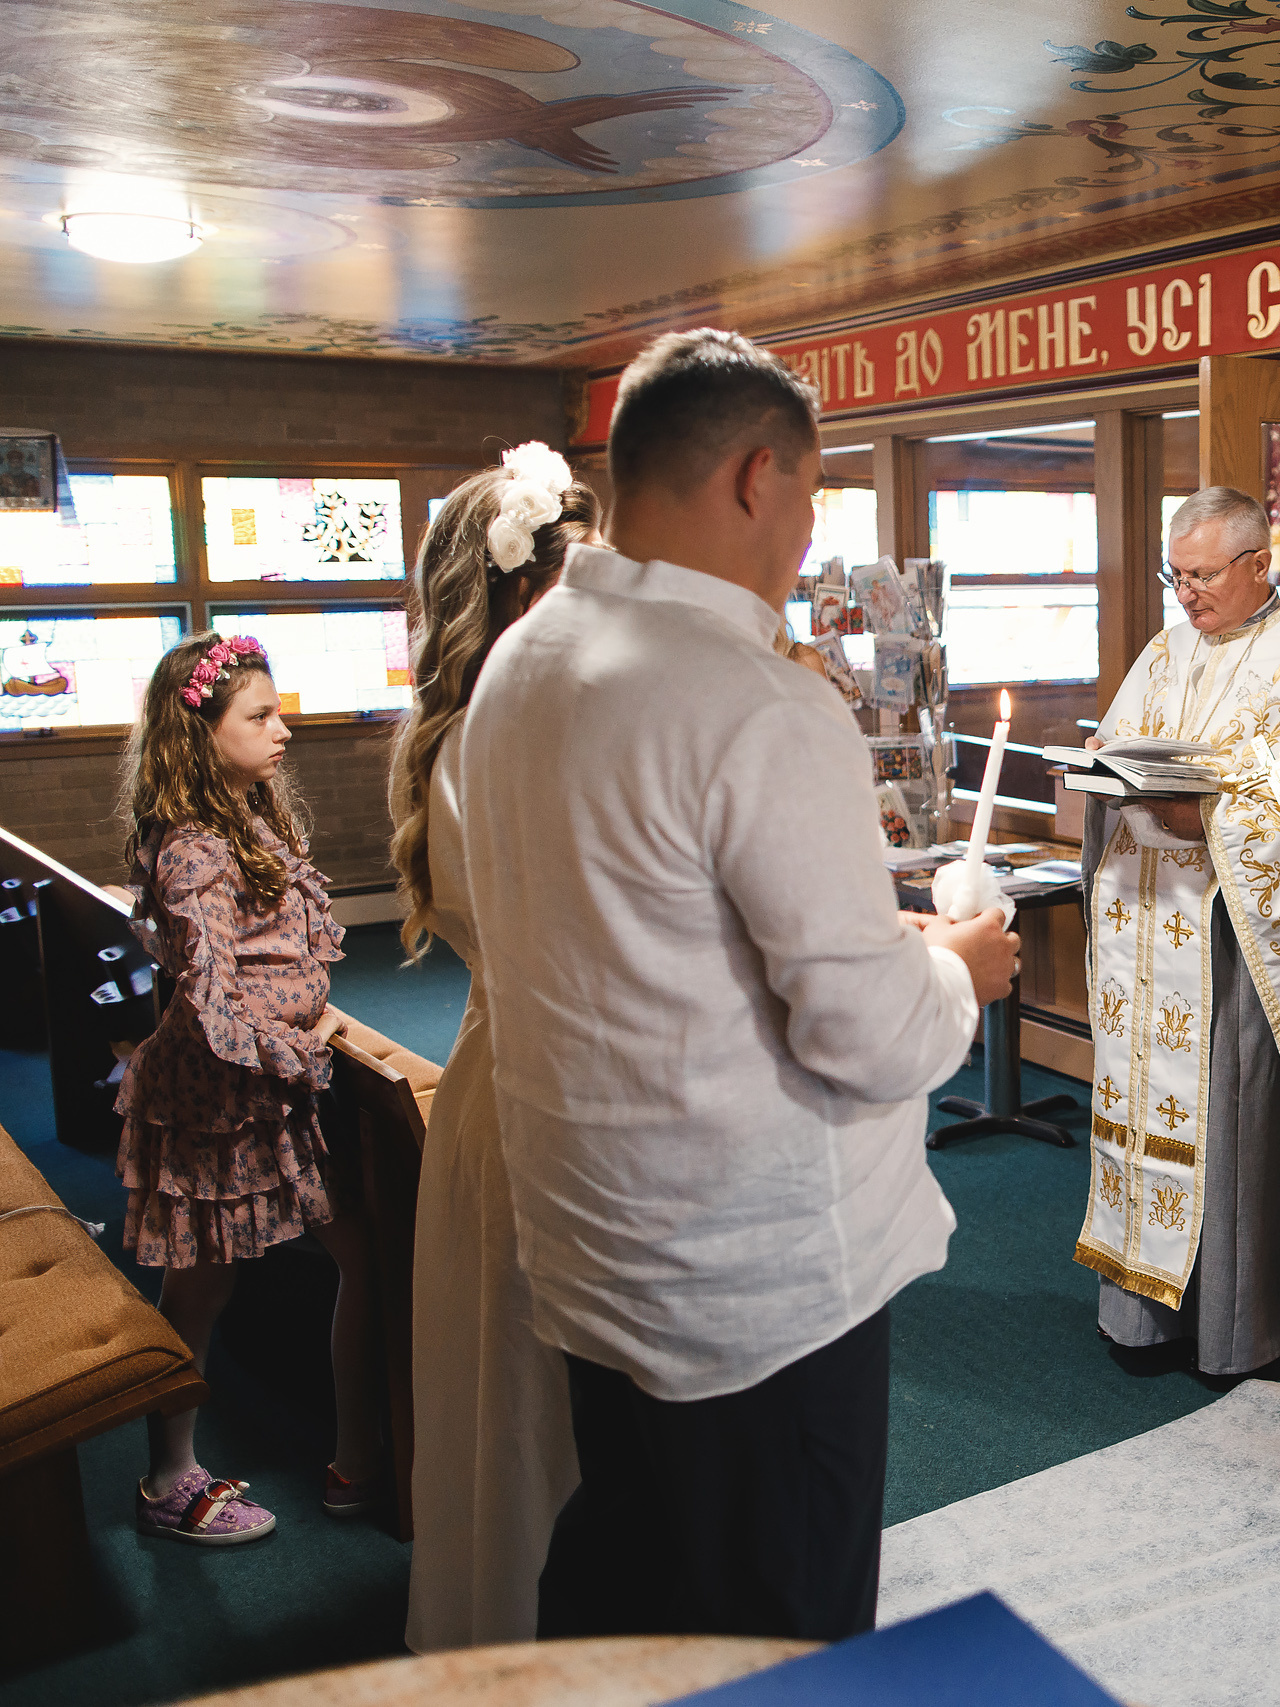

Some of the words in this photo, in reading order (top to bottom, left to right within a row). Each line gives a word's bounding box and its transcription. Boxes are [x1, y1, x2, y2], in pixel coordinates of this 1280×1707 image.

[894, 328, 944, 399] ДО
[966, 295, 1110, 380] МЕНЕ,
[1126, 272, 1212, 357] УСІ
